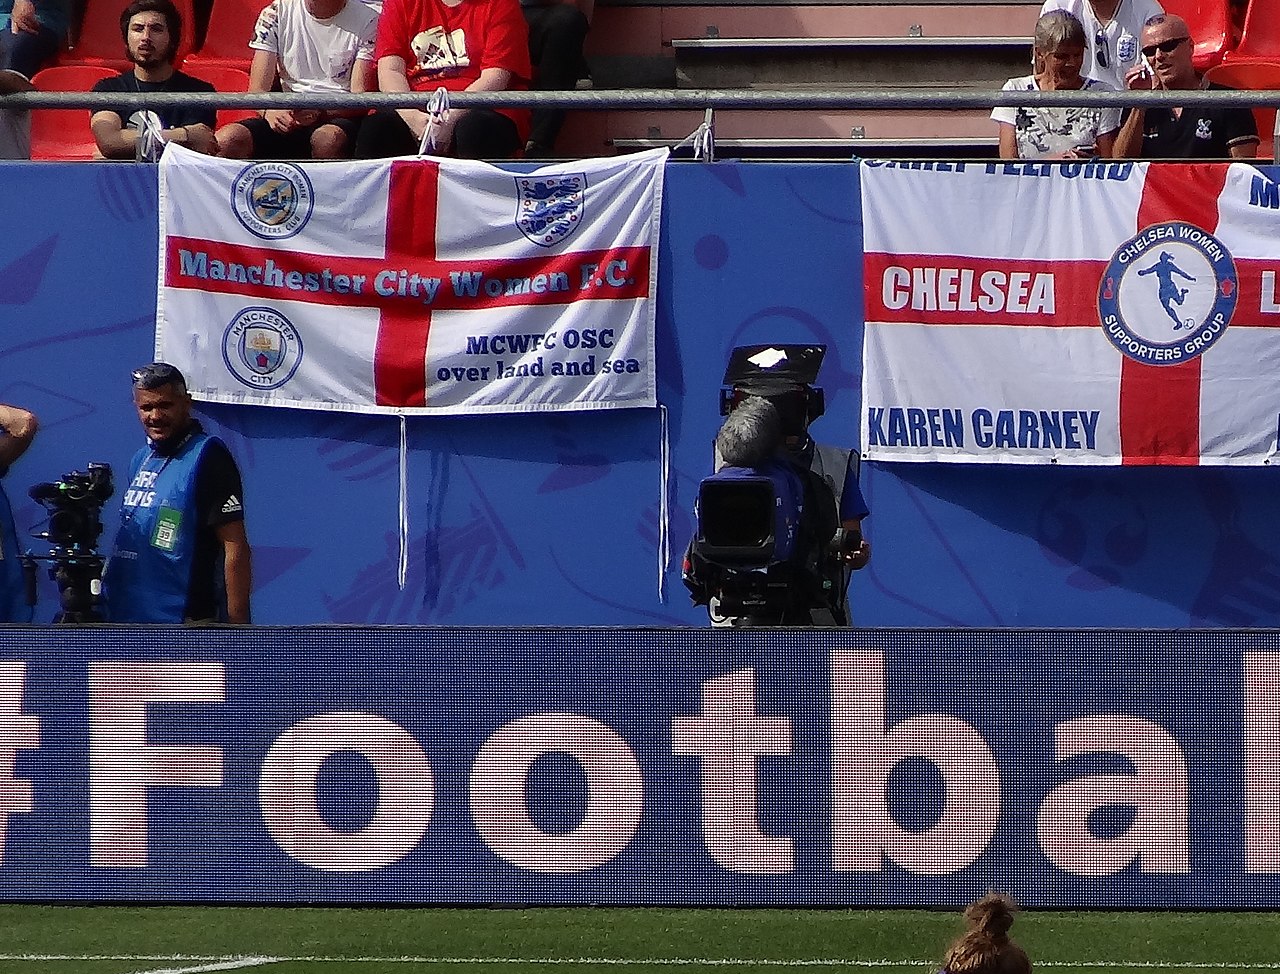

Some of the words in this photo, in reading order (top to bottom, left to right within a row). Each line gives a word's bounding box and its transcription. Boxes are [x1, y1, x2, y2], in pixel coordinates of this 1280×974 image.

[1117, 226, 1175, 264] CHELSEA
[1178, 226, 1224, 263] WOMEN
[178, 248, 366, 296] Manchester
[374, 268, 441, 304] City
[449, 269, 570, 298] Women
[580, 258, 636, 291] F.C.
[881, 265, 1056, 315] CHELSEA
[232, 313, 295, 341] MANCHESTER
[465, 331, 557, 356] MCWFC
[562, 327, 615, 351] OSC
[1104, 314, 1182, 360] SUPPORTERS
[1184, 312, 1226, 354] GROUP
[250, 375, 274, 385] CITY
[437, 364, 491, 383] over
[497, 356, 545, 381] land
[551, 354, 597, 378] and
[602, 356, 641, 375] sea
[867, 406, 964, 448] KAREN
[970, 407, 1100, 450] CARNEY
